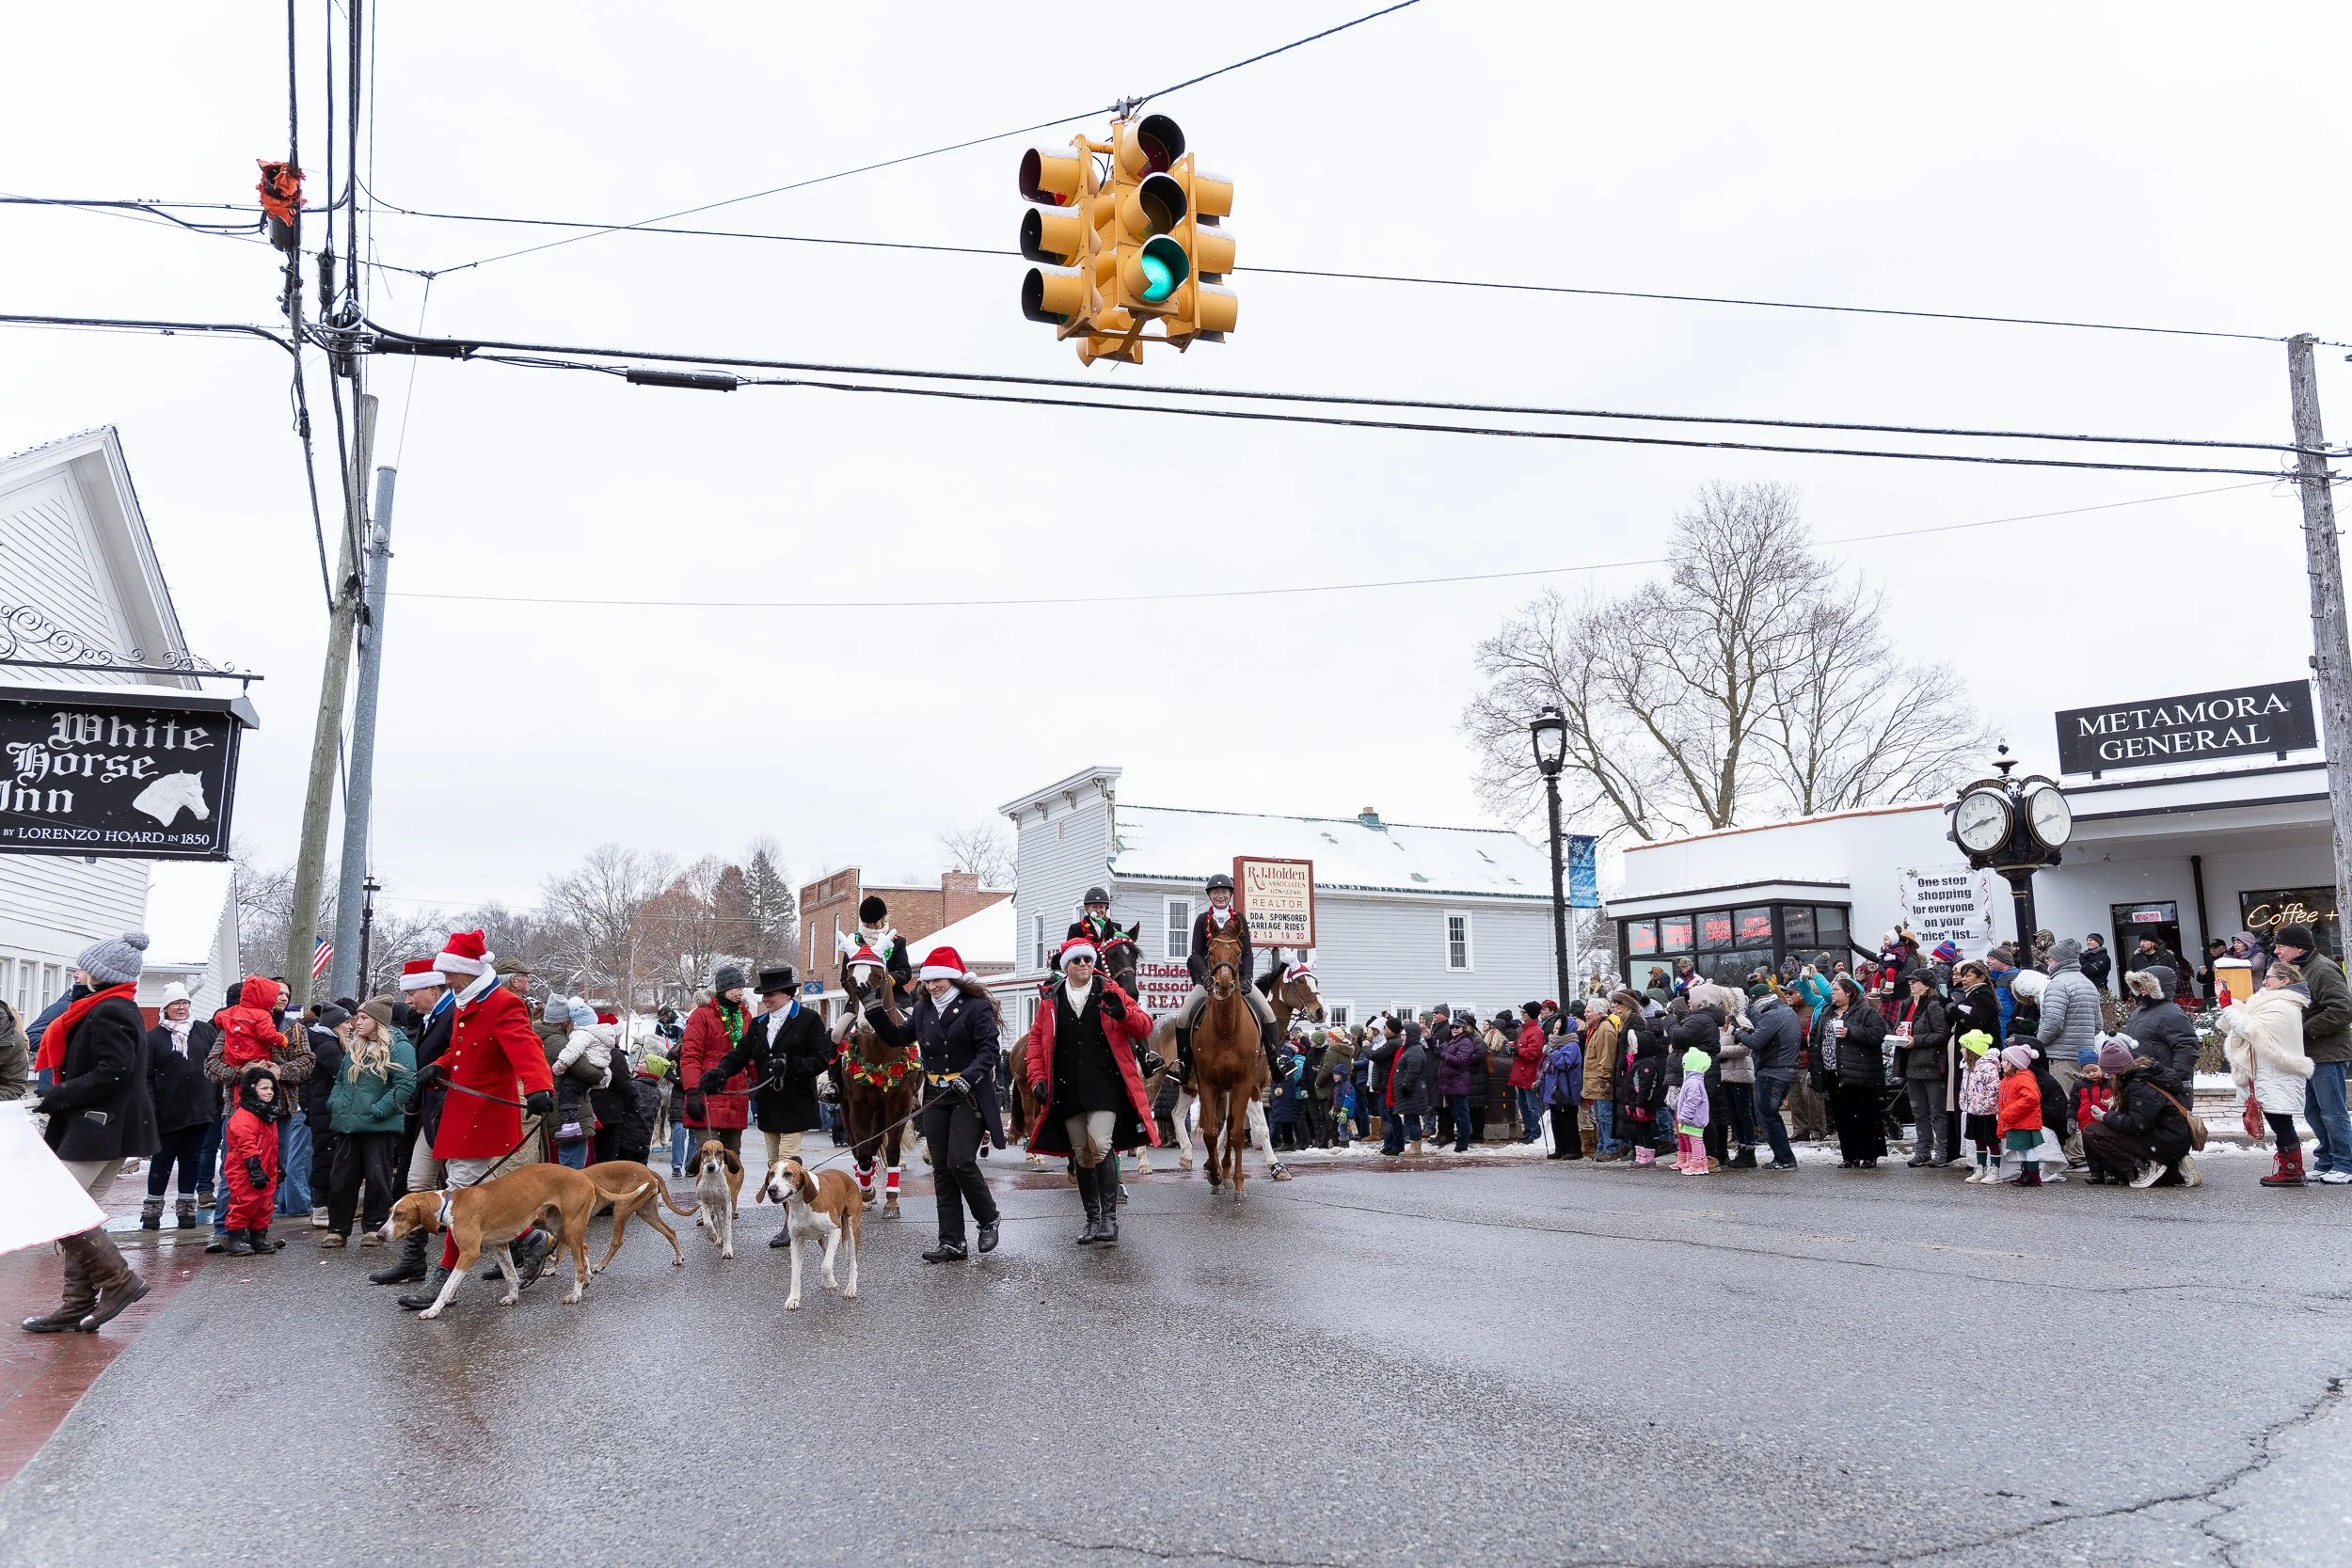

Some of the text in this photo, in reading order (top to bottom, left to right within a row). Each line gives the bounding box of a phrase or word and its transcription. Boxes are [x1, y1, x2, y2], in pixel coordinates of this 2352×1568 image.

[2077, 692, 2290, 736] METAMORA
[48, 711, 215, 751] White
[2099, 723, 2271, 761] GENERAL
[6, 741, 159, 786] Horse
[18, 827, 101, 841] LORENZO
[104, 831, 165, 844] HOARD
[167, 834, 178, 842] IN
[180, 833, 210, 845] 1850
[1917, 877, 1967, 887] One stop
[1917, 889, 1972, 901] shopping
[1252, 899, 1303, 908] REALTOR
[1912, 903, 1974, 915] for everyone
[1270, 914, 1307, 922] SPONSORED
[1744, 916, 1767, 927] GIFTS
[2134, 913, 2160, 922] OPEN
[2247, 903, 2319, 928] Coffee
[1705, 919, 1731, 931] BOOKS
[1924, 917, 1965, 928] on your
[1707, 931, 1731, 940] CARDS
[1742, 924, 1772, 937] GALORE
[1917, 930, 1979, 941] "nice" list...
[1138, 981, 1146, 990] &
